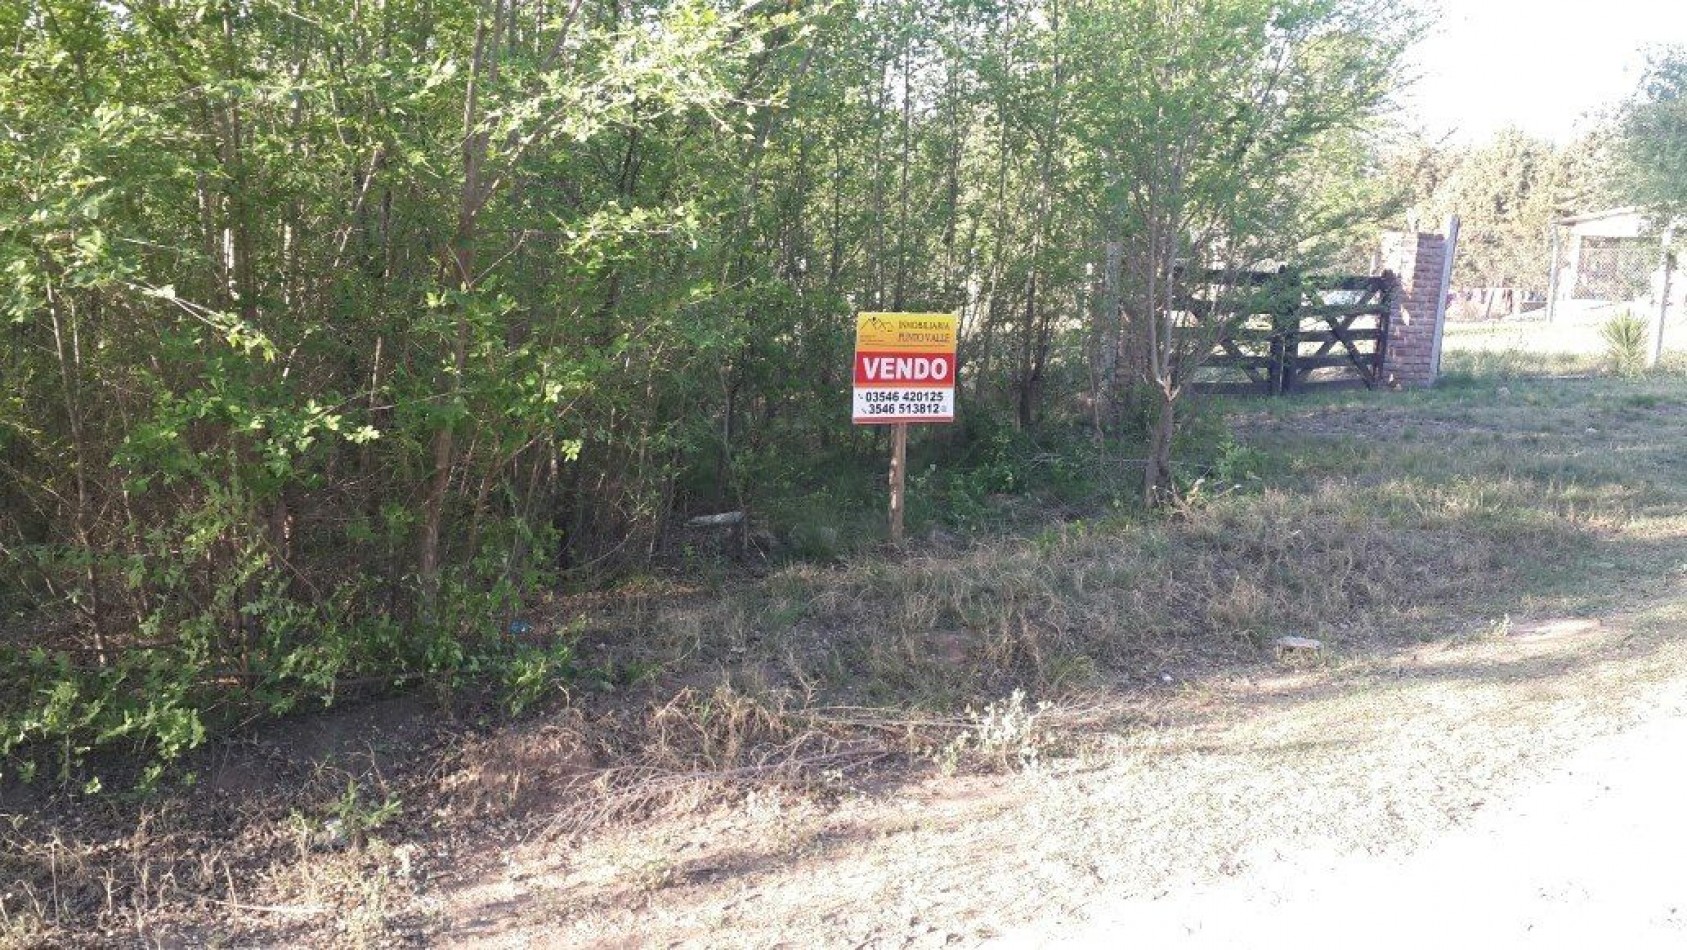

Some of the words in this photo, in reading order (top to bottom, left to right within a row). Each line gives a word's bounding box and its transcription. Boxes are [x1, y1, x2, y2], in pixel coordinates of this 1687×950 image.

[925, 333, 950, 343] VALLE
[862, 357, 948, 380] VENDO
[865, 391, 900, 402] 03546
[902, 391, 944, 402] 420125
[868, 403, 895, 414] 3546
[899, 403, 940, 414] 513812
